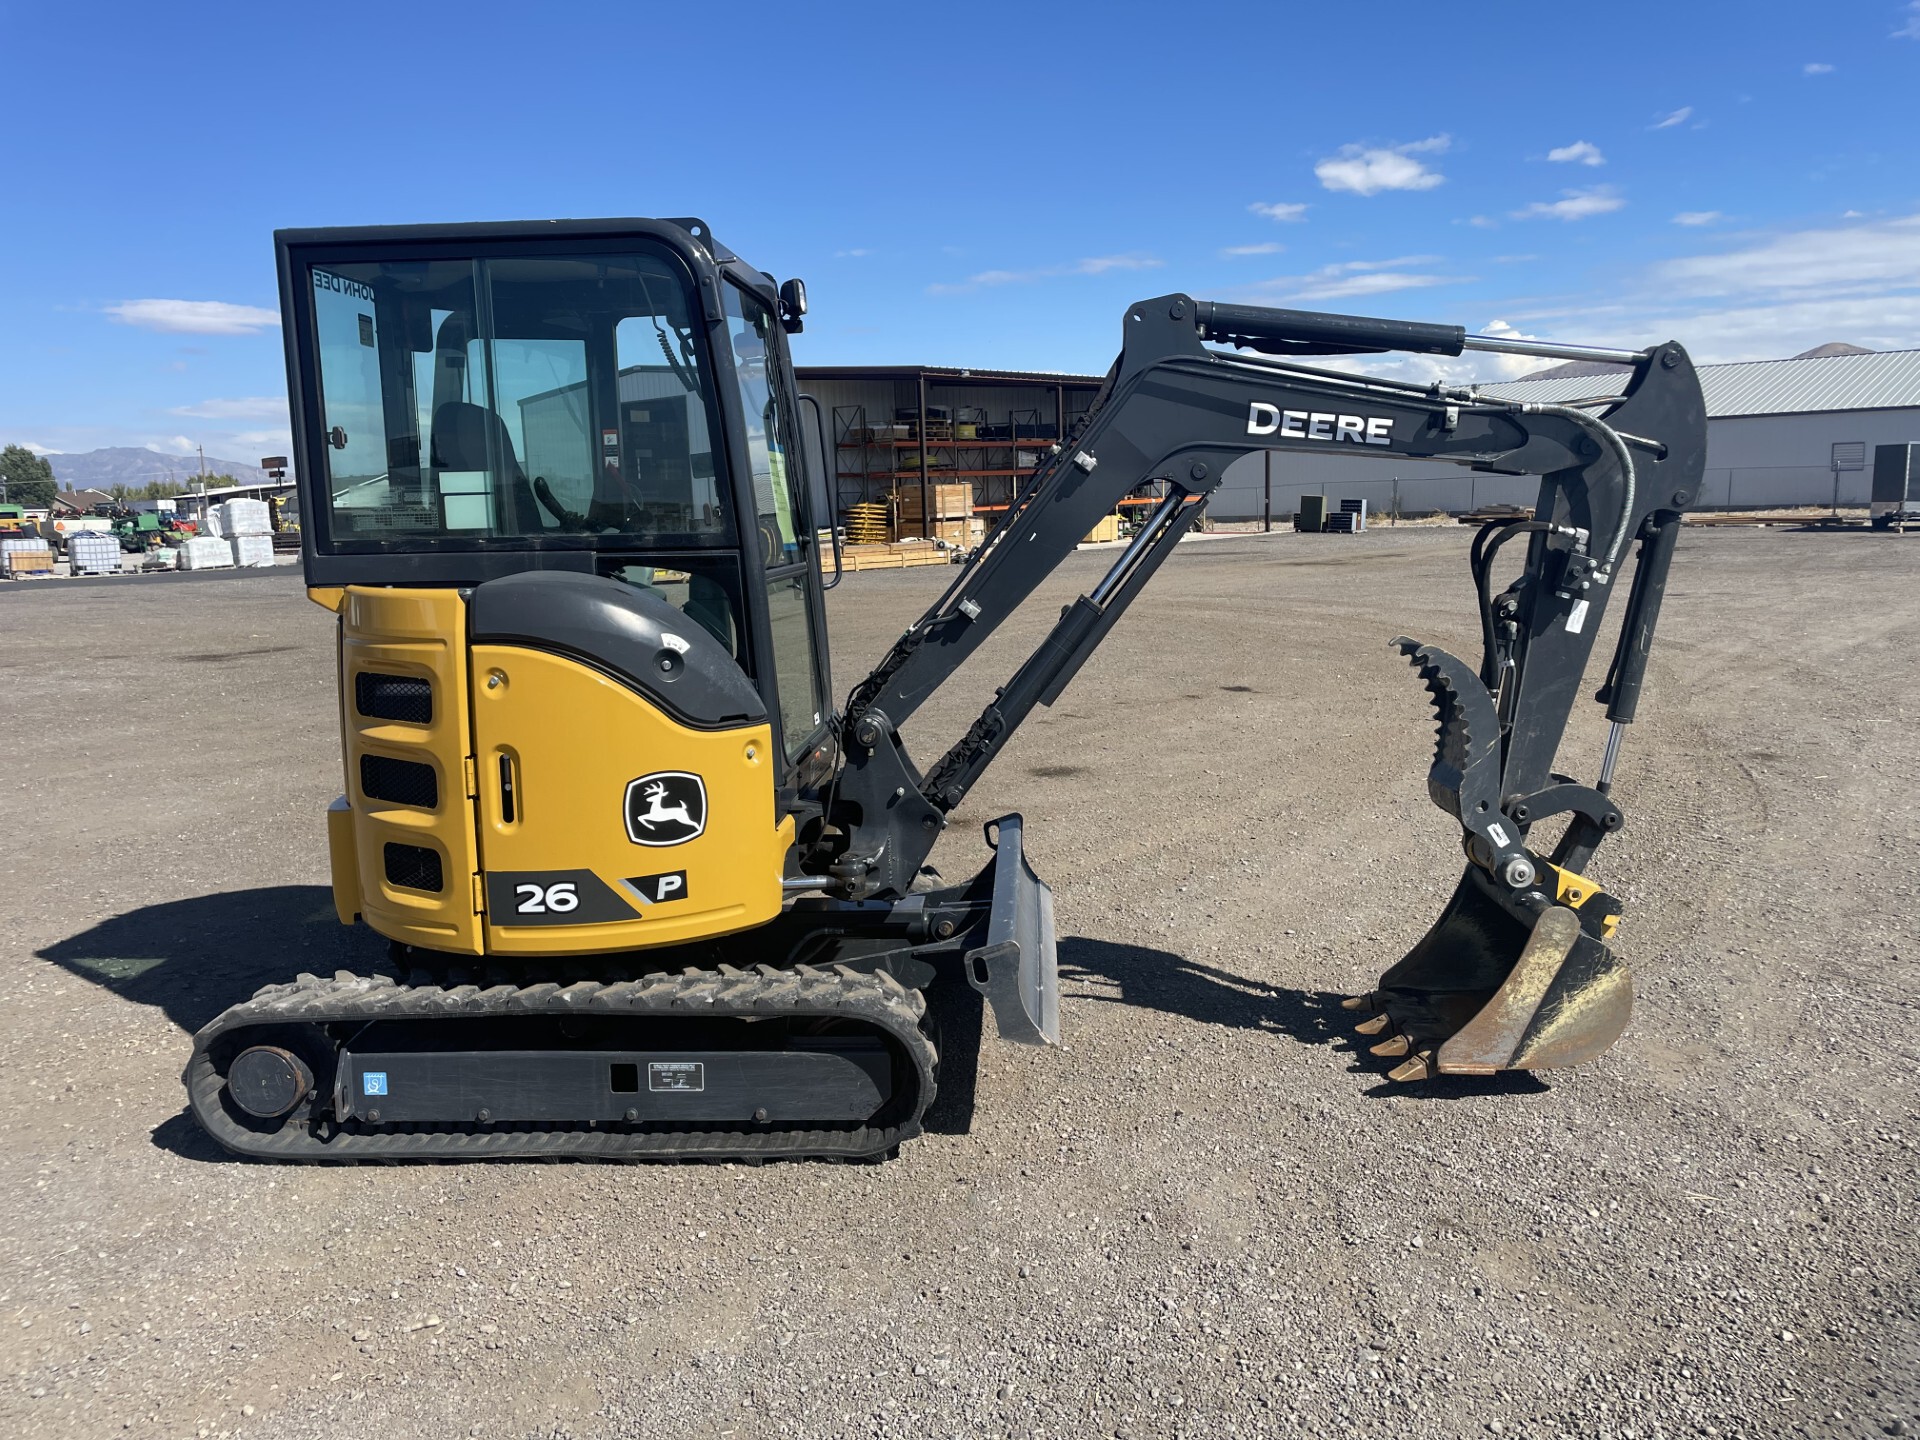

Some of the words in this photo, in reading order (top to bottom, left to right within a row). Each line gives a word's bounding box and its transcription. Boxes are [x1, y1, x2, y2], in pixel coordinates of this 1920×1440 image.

[1247, 401, 1394, 445] DEERE
[516, 883, 579, 913] 26
[656, 875, 682, 900] P
